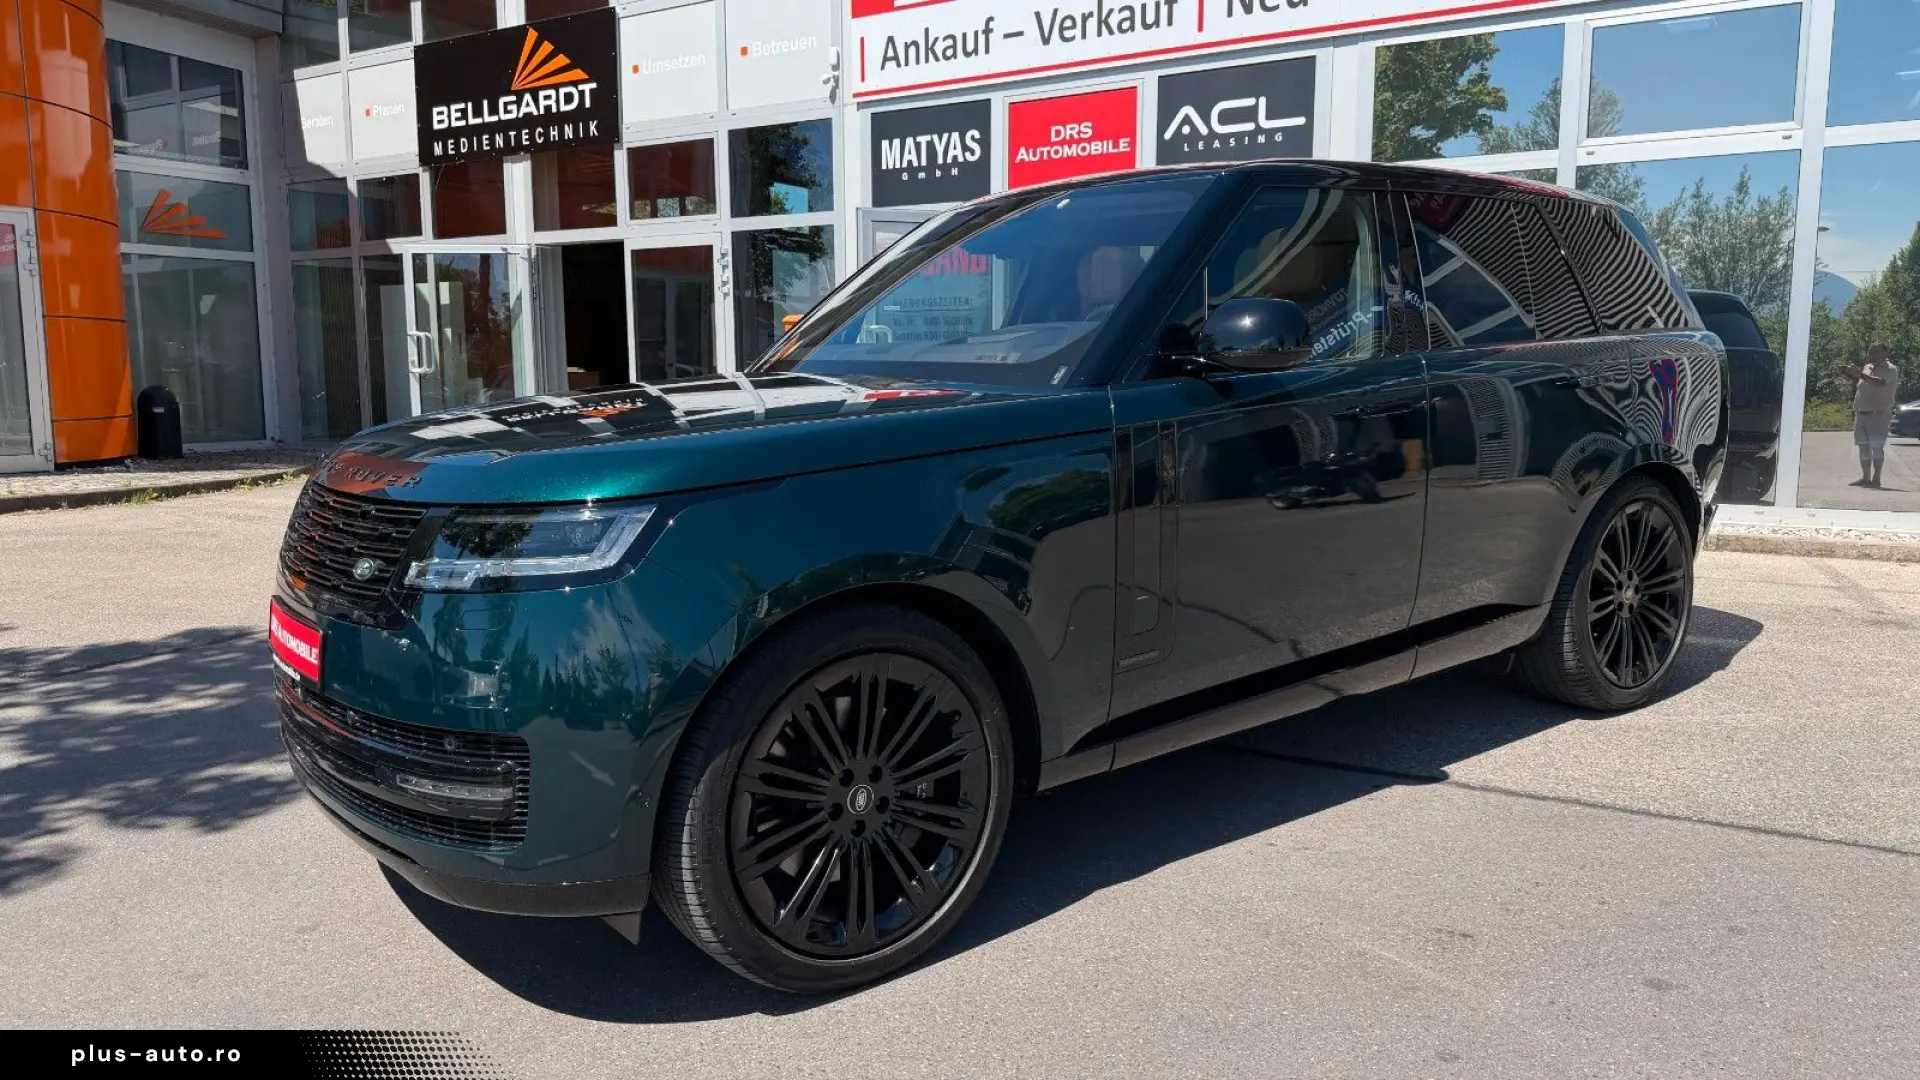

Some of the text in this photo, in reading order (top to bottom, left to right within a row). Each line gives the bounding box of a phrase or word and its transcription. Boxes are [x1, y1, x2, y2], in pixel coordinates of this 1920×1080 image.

[752, 35, 817, 57] Betreuen
[880, 16, 995, 71] Ankauf
[1034, 0, 1178, 46] Verkauf
[642, 53, 706, 75] Umsetzen
[373, 103, 405, 117] Planen
[432, 82, 597, 130] BELLGARDT
[1163, 96, 1306, 140] ACL
[433, 120, 598, 156] MEDIENTECHNIK
[1050, 121, 1093, 143] DRS
[1183, 132, 1283, 152] LEASING
[881, 129, 981, 170] MATYAS
[1015, 138, 1131, 164] AUTOMOBILE
[901, 168, 959, 181] GmbH
